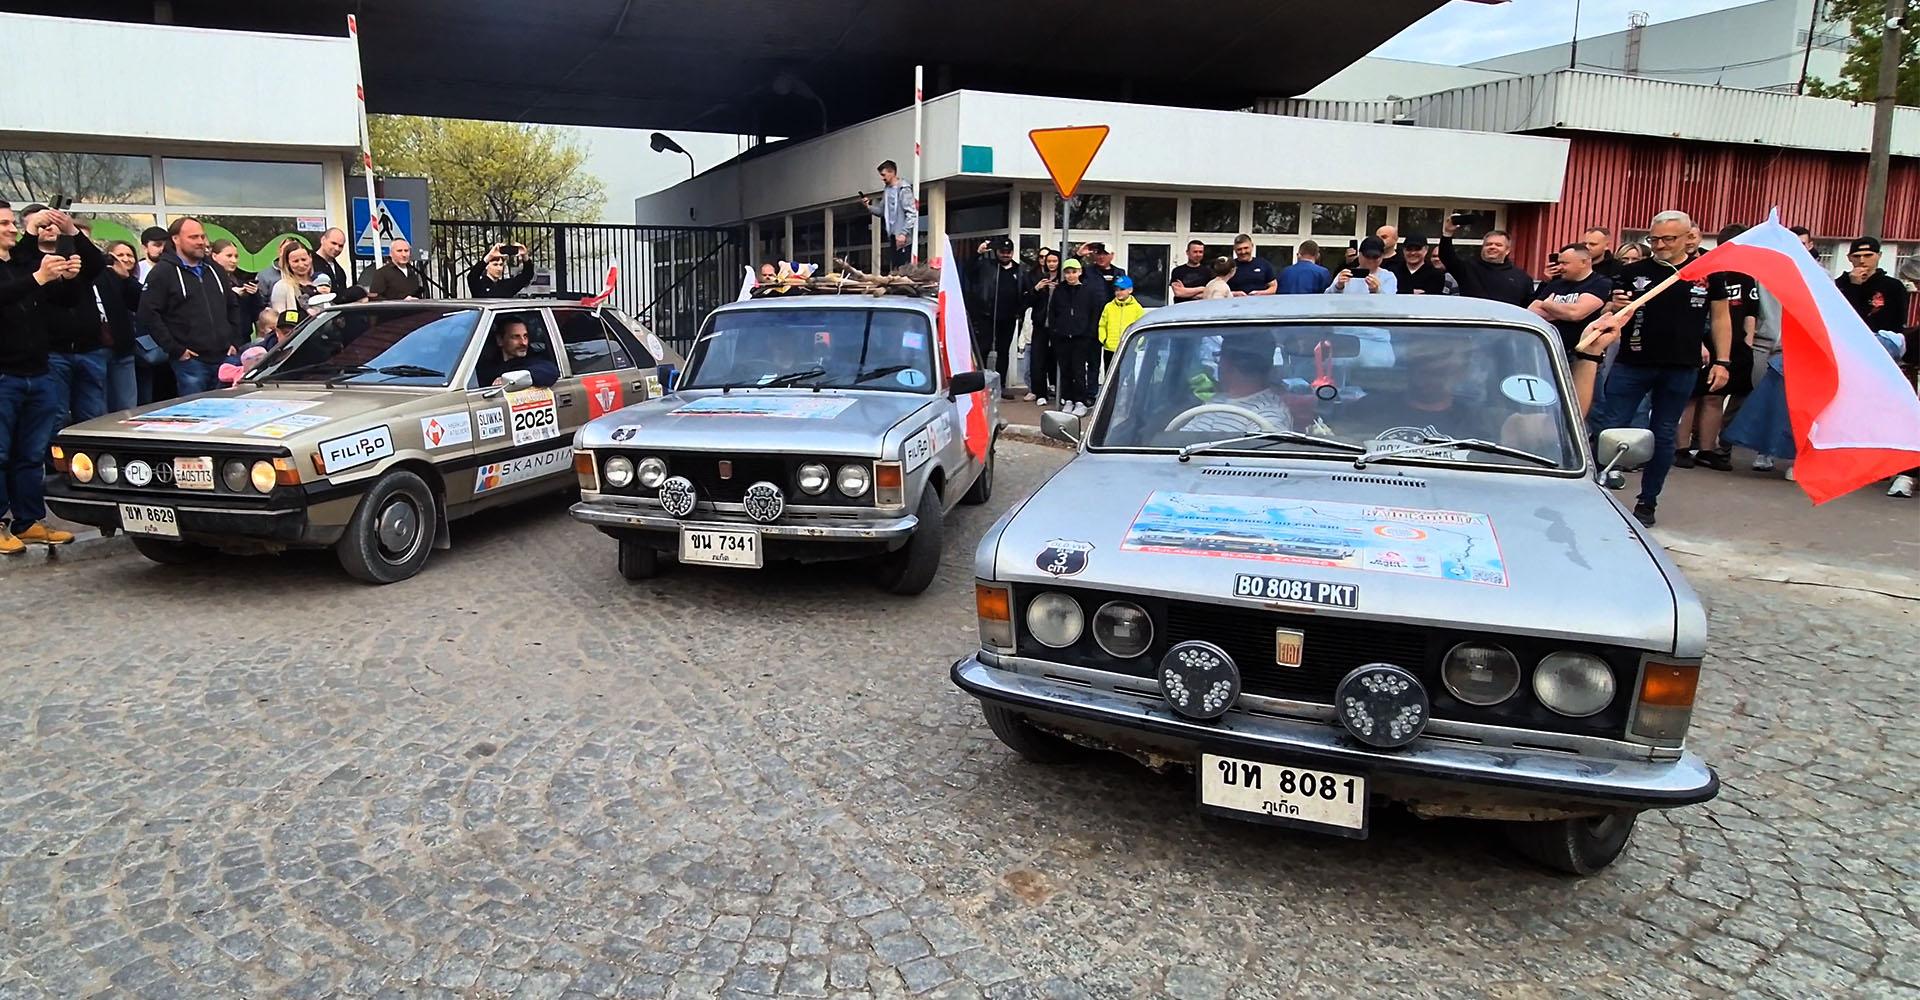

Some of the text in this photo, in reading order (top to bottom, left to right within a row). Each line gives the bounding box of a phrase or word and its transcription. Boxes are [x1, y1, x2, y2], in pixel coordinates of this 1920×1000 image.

[1517, 377, 1539, 402] T
[514, 407, 555, 432] 2025
[331, 437, 385, 462] FILIPPO
[131, 466, 145, 481] PL
[146, 507, 174, 524] 8629
[719, 535, 754, 552] 7341
[1047, 564, 1069, 574] CITY
[1054, 552, 1069, 567] 3
[1266, 578, 1313, 602] 8081
[1317, 583, 1354, 606] PKT
[1280, 643, 1300, 664] FIAT
[1218, 759, 1355, 804] ขท 8081
